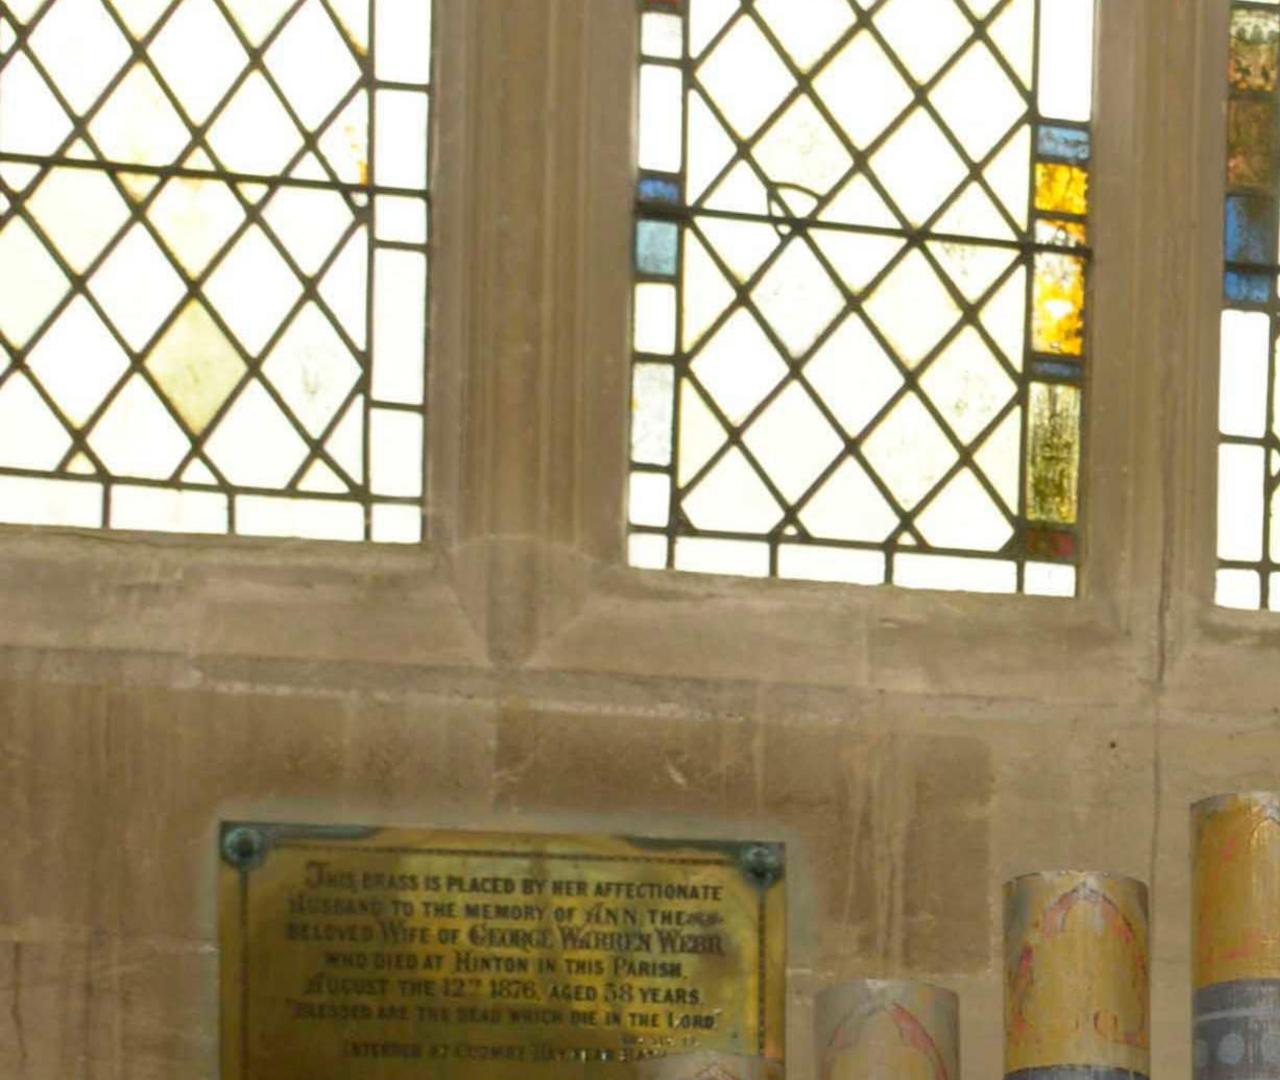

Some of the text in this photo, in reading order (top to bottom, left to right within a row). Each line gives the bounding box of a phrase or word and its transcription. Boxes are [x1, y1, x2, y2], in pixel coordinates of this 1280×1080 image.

[306, 861, 723, 902] THIS BRASS IS PLACED BY HER AFFECTIONATE
[391, 900, 414, 917] TO
[421, 901, 457, 919] THE
[464, 903, 545, 922] MEMORY
[554, 906, 578, 924] OF
[647, 909, 687, 926] THE
[286, 921, 375, 942] BELOVED
[379, 919, 431, 945] WIFE
[437, 927, 460, 945] OF
[467, 923, 554, 951] GEORGE
[325, 951, 368, 970] WHO
[373, 952, 419, 970] DIED
[423, 953, 444, 971] AT
[455, 950, 529, 974] HINTON
[537, 957, 556, 973] IN
[565, 958, 605, 976] THIS
[304, 972, 389, 996] AUGUST
[398, 979, 436, 997] THE
[548, 985, 598, 1003] AGED
[508, 1007, 563, 1025] WHICH
[570, 1010, 597, 1026] DIE
[605, 1011, 621, 1026] IN
[629, 1012, 661, 1028] THE
